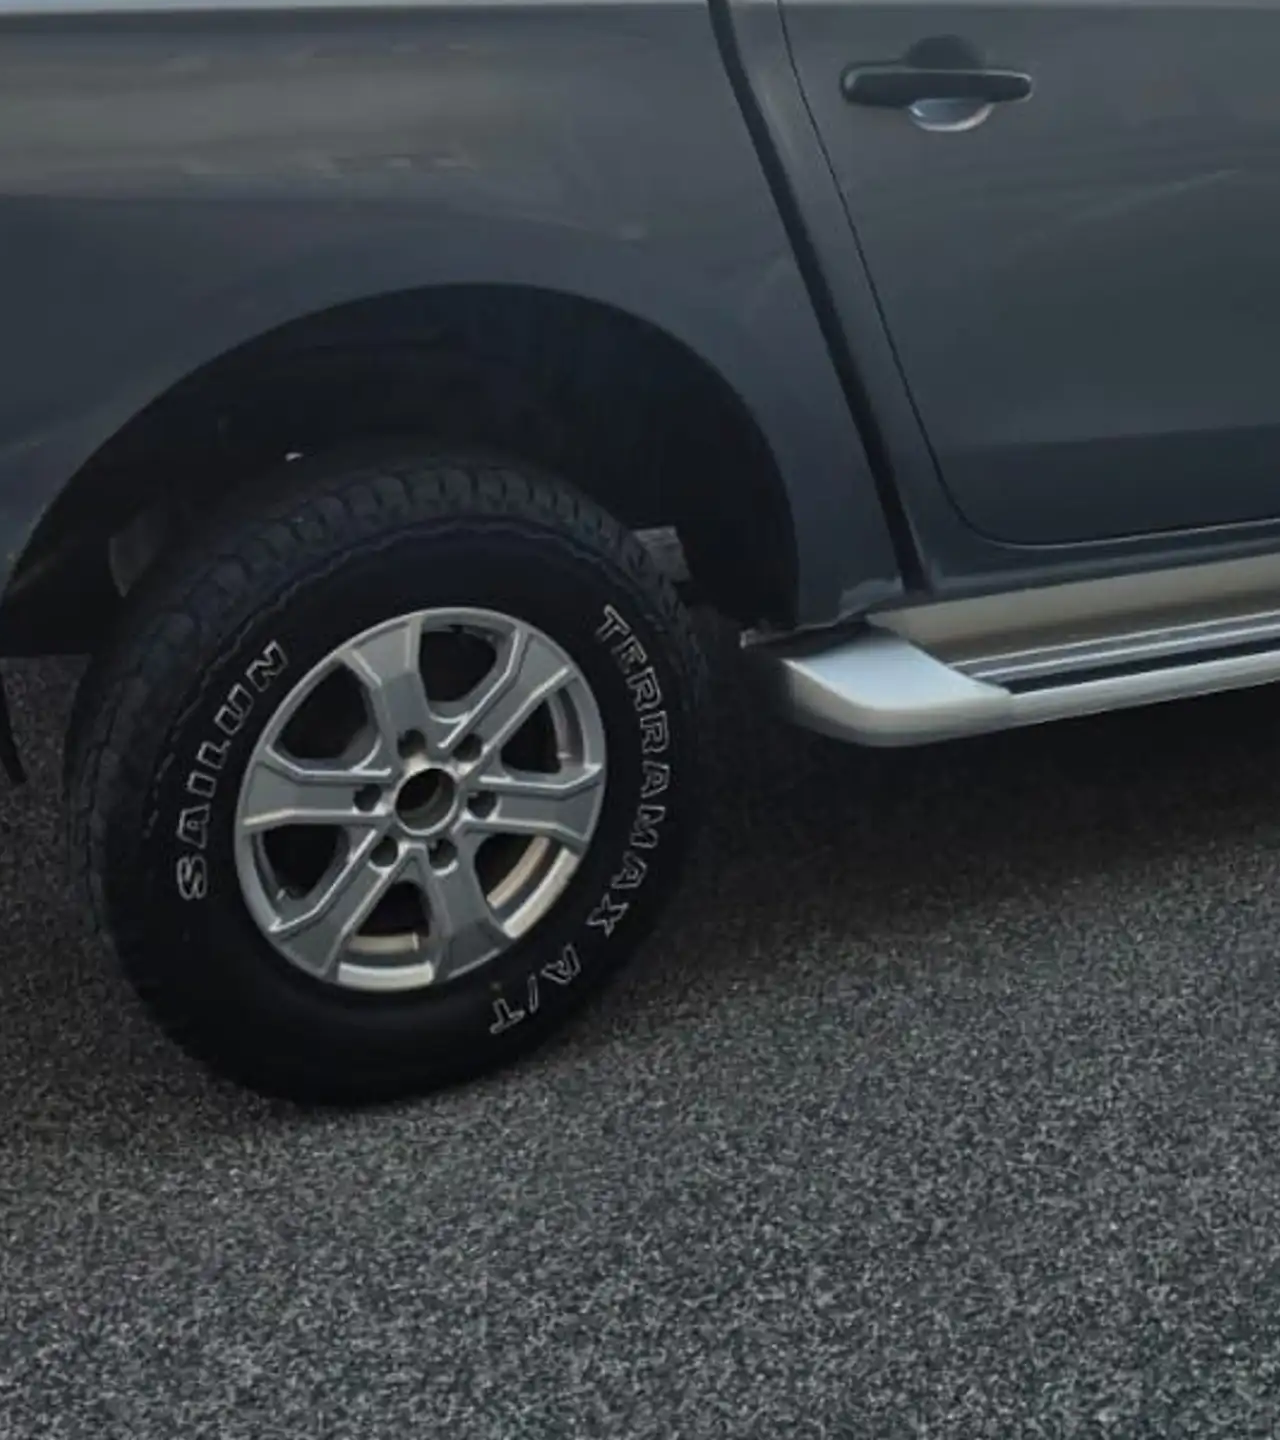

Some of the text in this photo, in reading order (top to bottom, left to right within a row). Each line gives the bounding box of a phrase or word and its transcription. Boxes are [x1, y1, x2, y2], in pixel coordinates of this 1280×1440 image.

[176, 639, 289, 900] SAILUN
[489, 604, 670, 1034] TERRAMAX A/T
